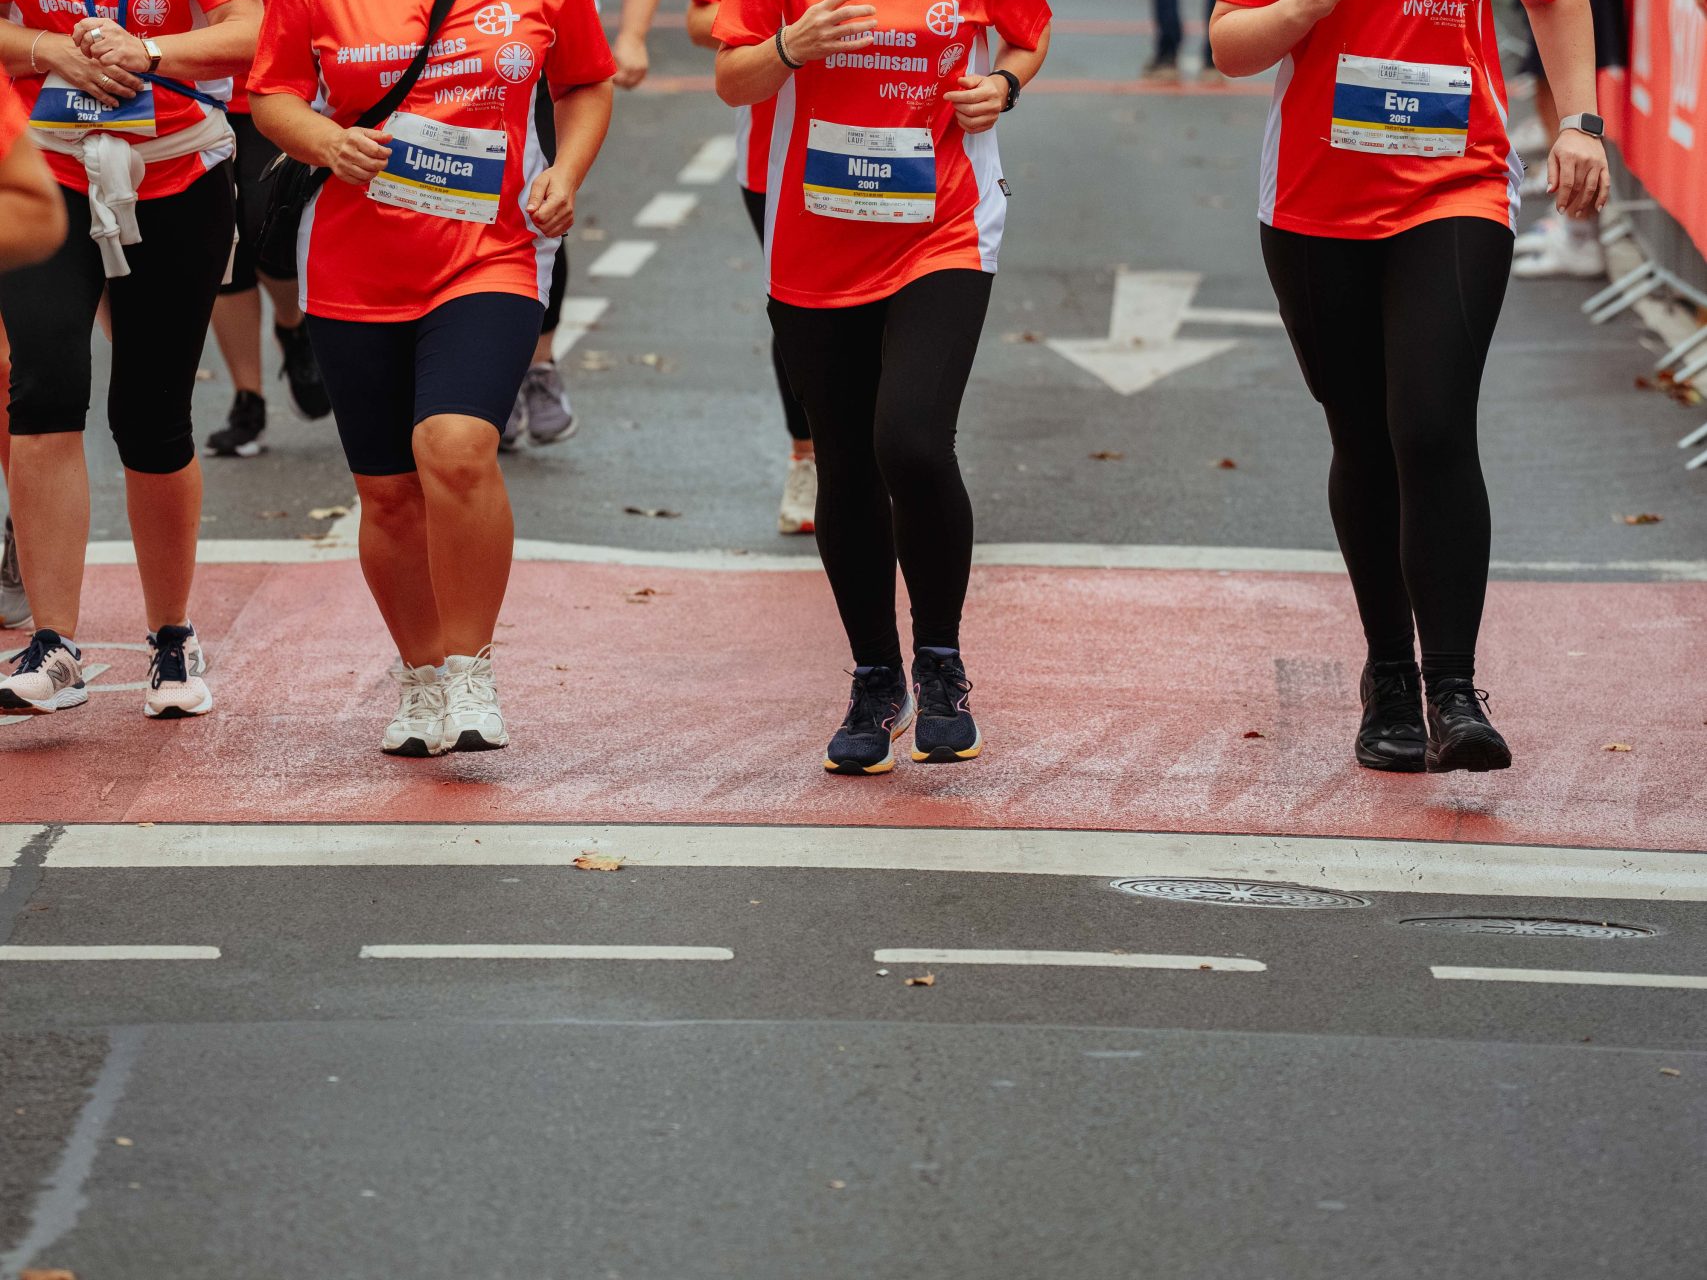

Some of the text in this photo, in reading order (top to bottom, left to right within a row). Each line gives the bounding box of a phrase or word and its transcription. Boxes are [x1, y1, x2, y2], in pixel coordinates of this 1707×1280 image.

[825, 52, 928, 73] gemeinsam
[1384, 91, 1420, 113] Eva
[77, 113, 99, 121] 2073
[1389, 114, 1411, 124] 2051
[404, 146, 474, 178] Ljubica
[847, 157, 892, 179] Nina
[425, 173, 447, 186] 2204
[857, 180, 879, 190] 2001
